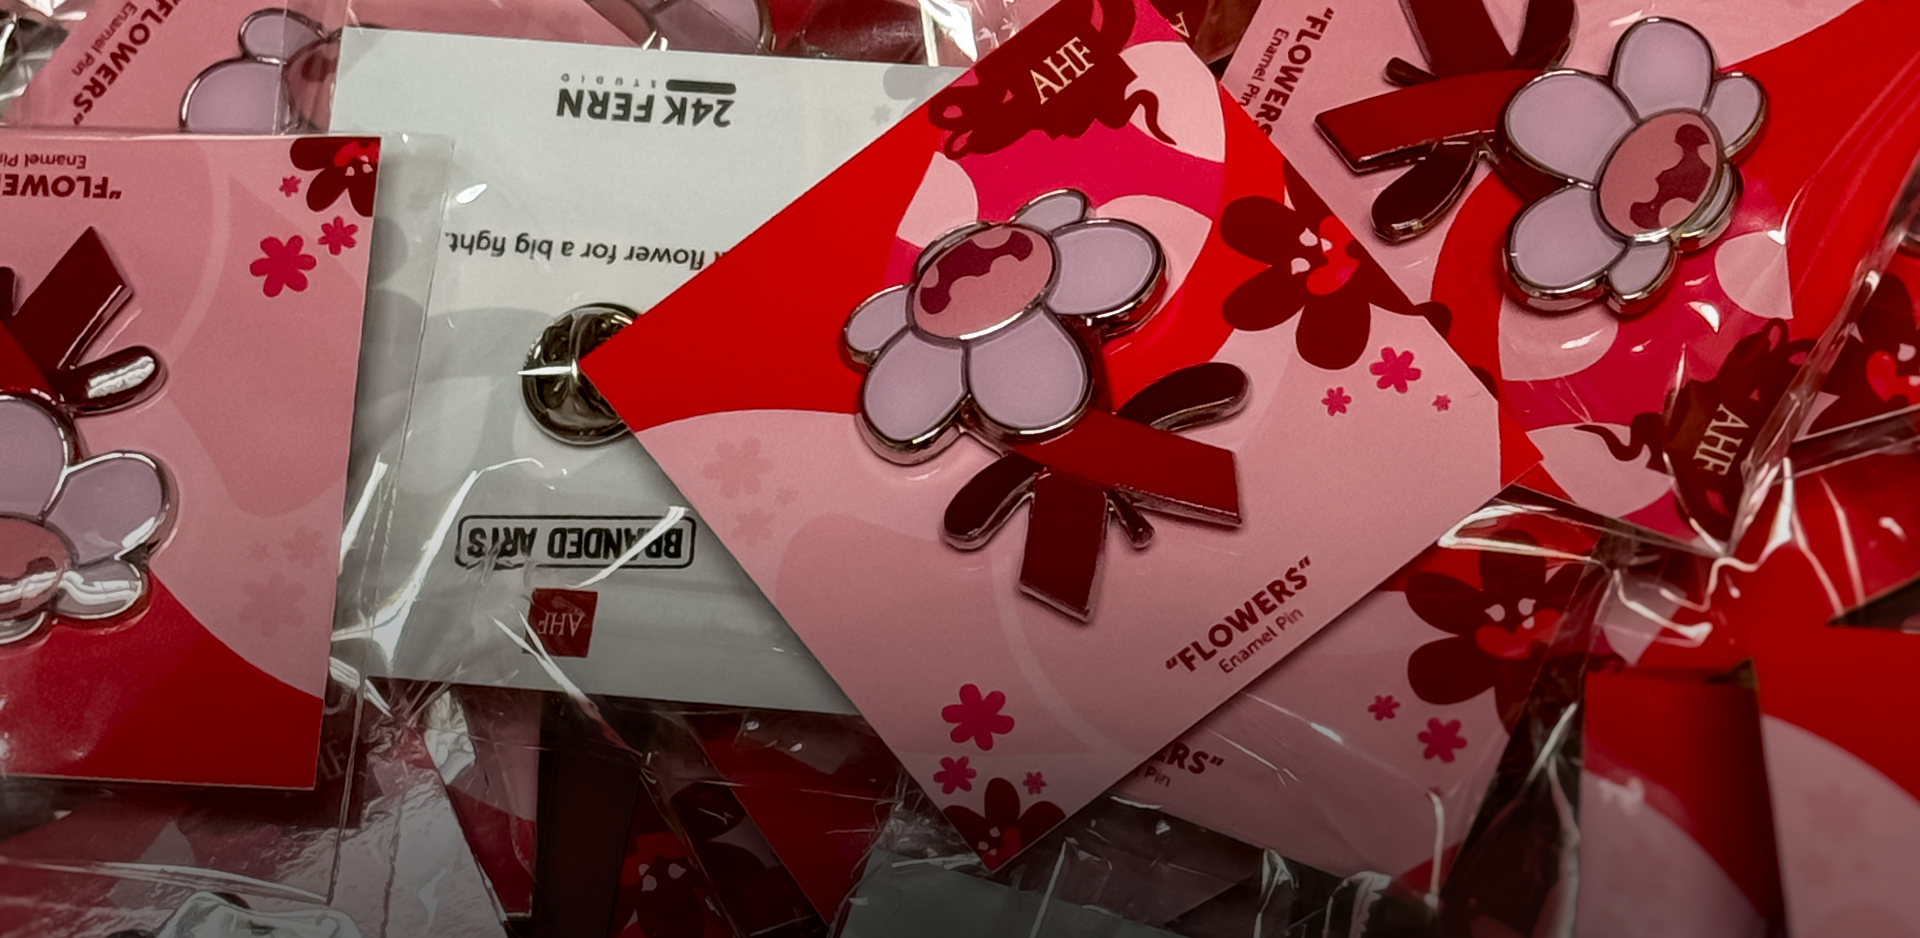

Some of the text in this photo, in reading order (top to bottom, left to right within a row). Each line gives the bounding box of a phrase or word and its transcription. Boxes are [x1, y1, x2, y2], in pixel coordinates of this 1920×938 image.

[71, 1, 138, 77] Enamel Pin
[560, 73, 657, 89] STUDIO
[1029, 36, 1095, 105] AHF
[1239, 28, 1289, 106] Enamel Pin
[556, 88, 735, 127] 24K FERN
[24, 153, 87, 170] Enamel
[445, 230, 507, 260] fight.
[515, 232, 553, 260] big
[562, 243, 574, 257] a
[581, 243, 617, 265] for
[625, 247, 705, 271] flower
[1693, 404, 1750, 476] AHF
[466, 527, 684, 560] BRANDED ARTS
[537, 612, 585, 637] AHF
[1219, 607, 1304, 674] Enamel Pin
[1144, 765, 1171, 787] Pin
